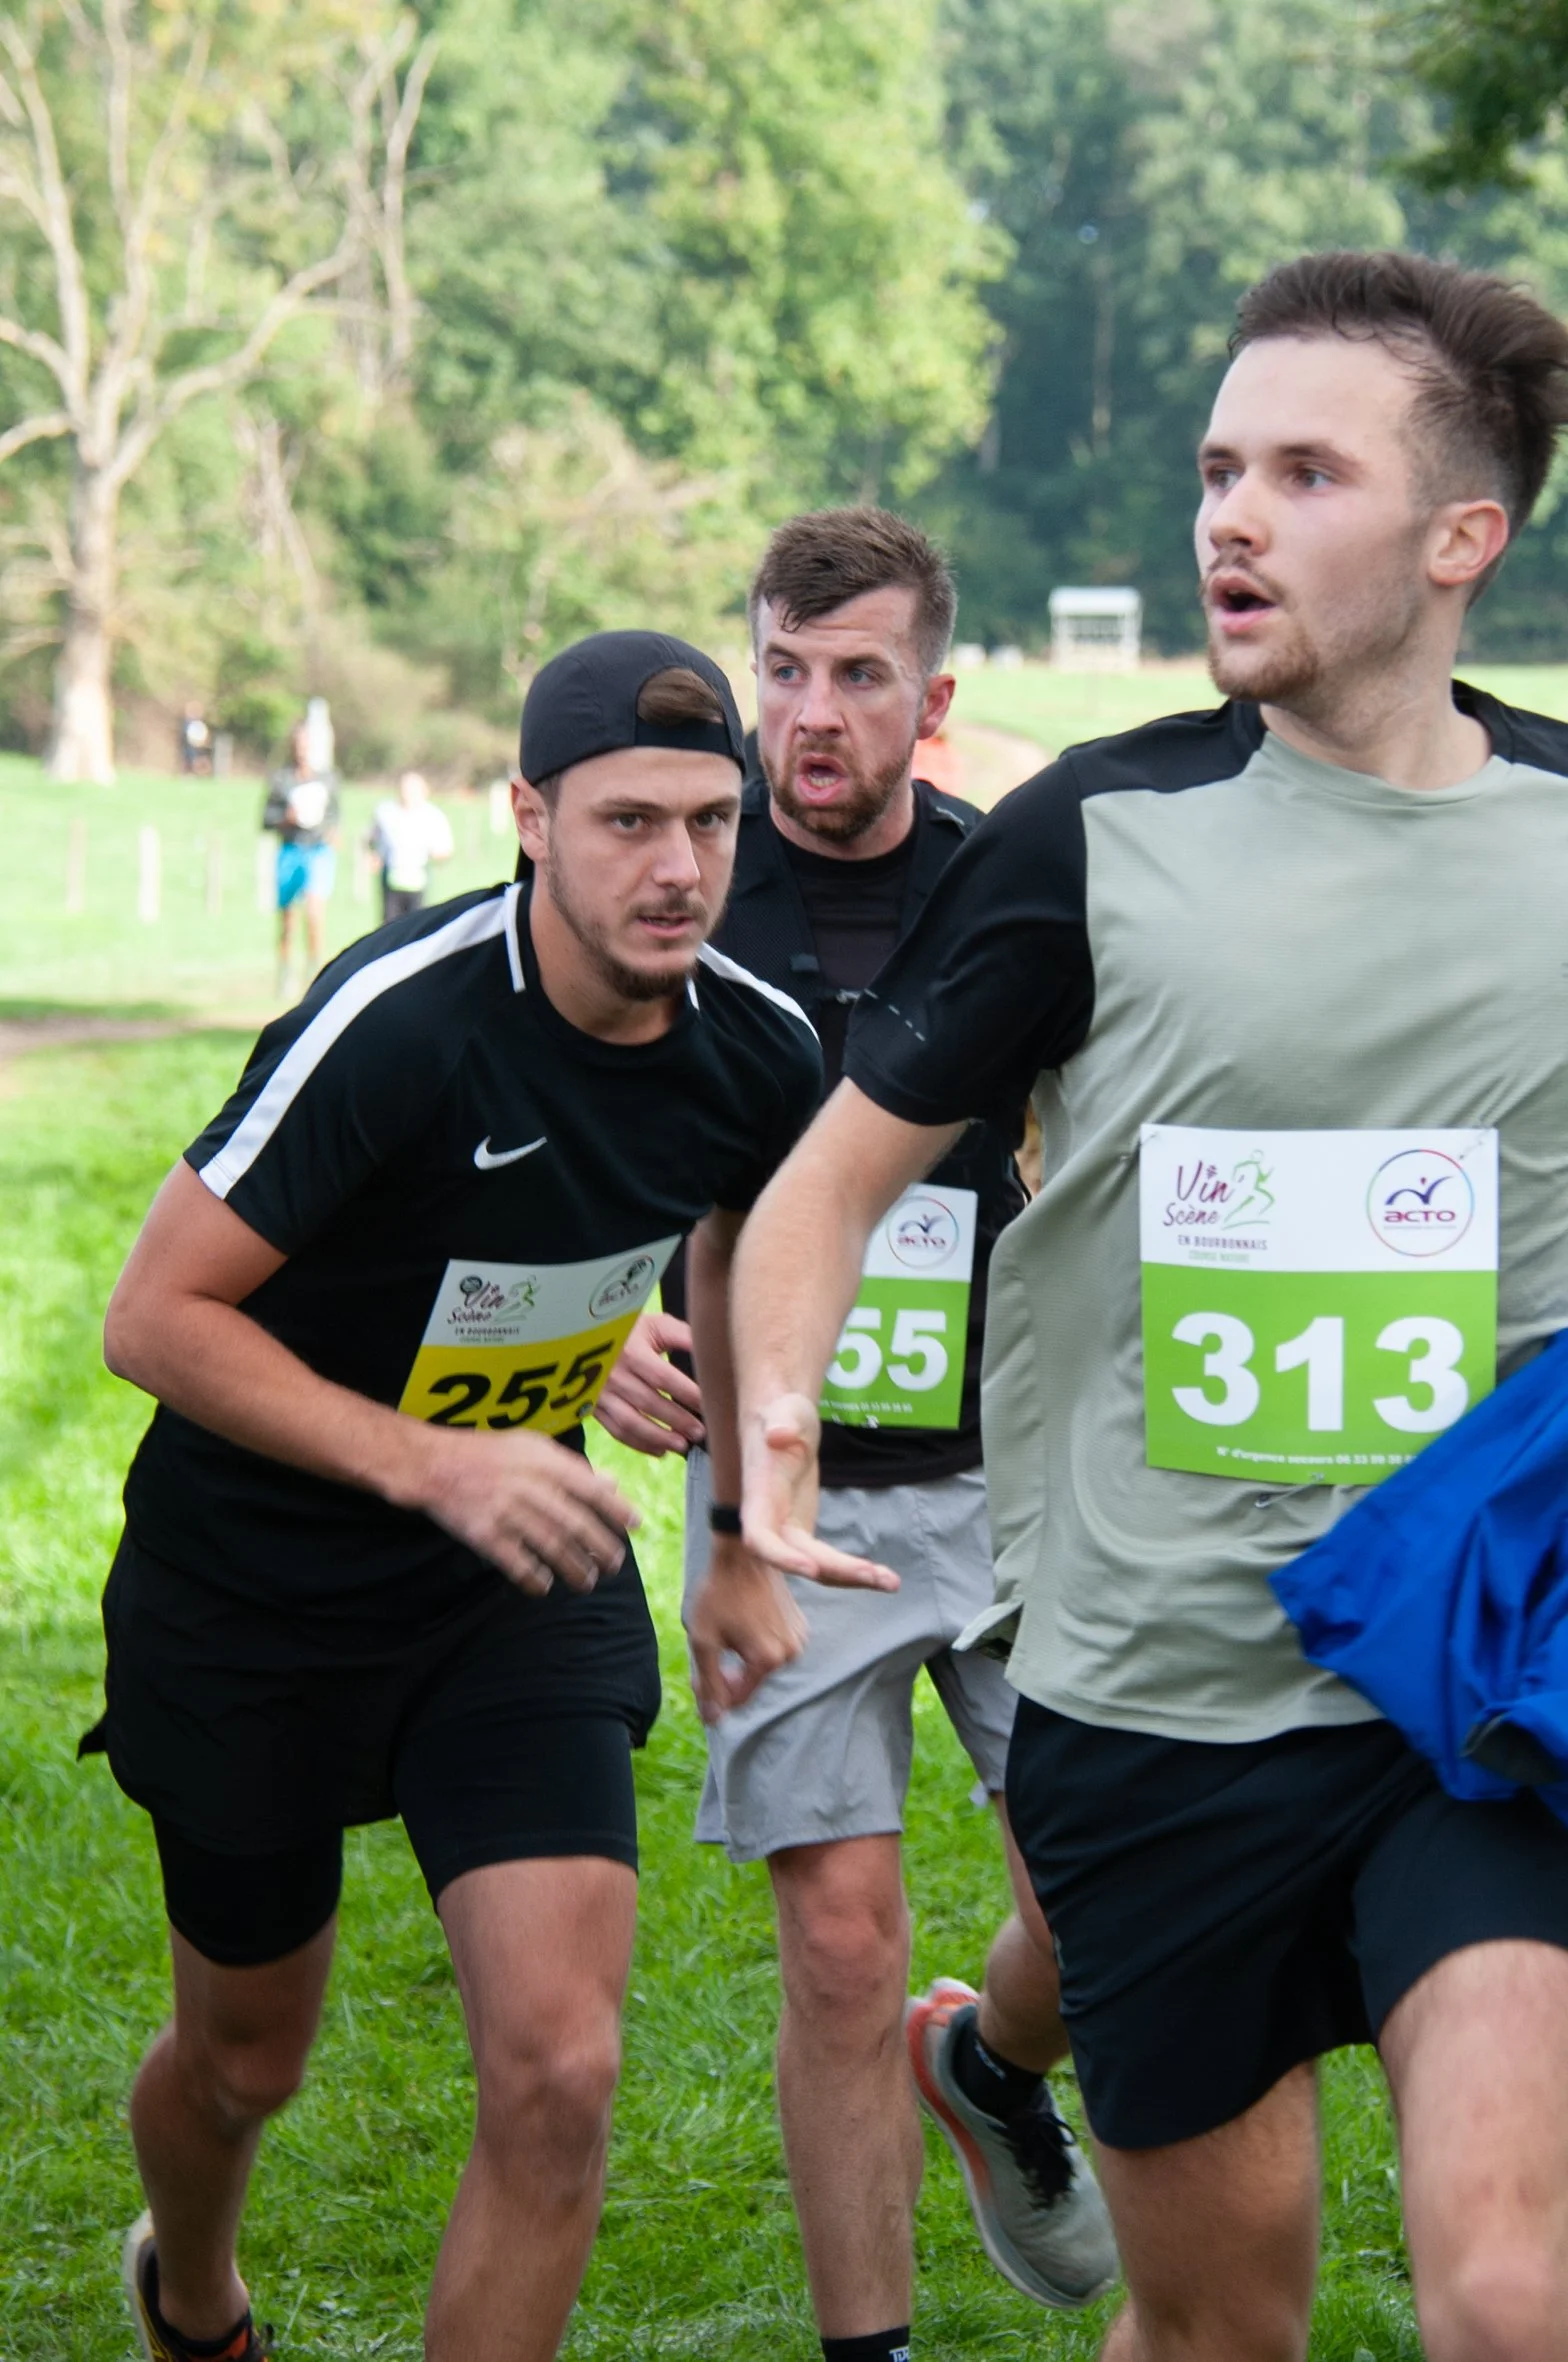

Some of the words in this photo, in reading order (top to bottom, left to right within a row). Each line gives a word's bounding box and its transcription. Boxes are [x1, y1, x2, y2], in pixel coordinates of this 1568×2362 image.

[1162, 1201, 1219, 1227] Scène
[426, 1339, 615, 1430] 255
[1171, 1311, 1469, 1433] 313
